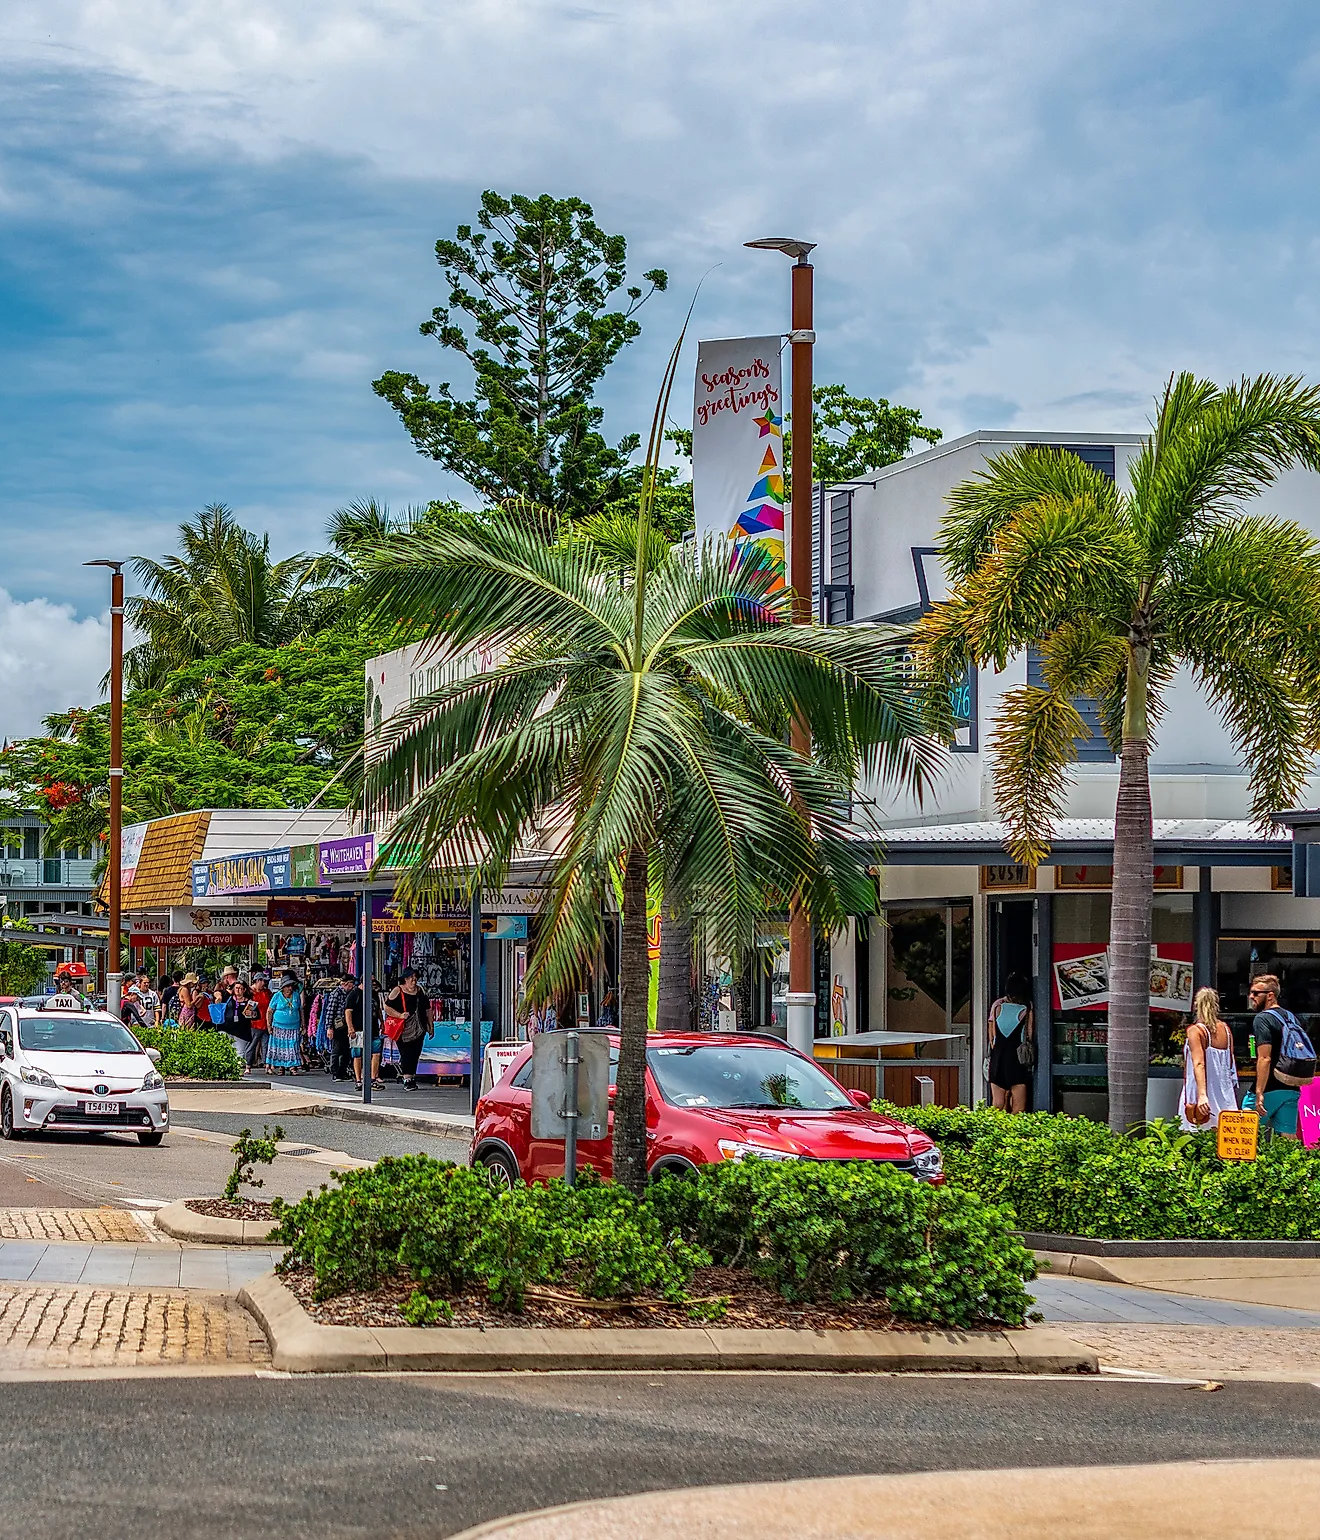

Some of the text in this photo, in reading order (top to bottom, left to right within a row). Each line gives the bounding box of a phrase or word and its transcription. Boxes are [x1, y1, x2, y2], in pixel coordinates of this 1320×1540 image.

[701, 358, 770, 393] season's
[697, 382, 779, 426] greetings
[330, 846, 364, 863] WHITEHAVEN
[481, 893, 522, 905] ROMA
[133, 920, 166, 931] WHERE
[212, 917, 257, 927] TRADING
[152, 934, 233, 946] Whitsunday Travel
[54, 999, 73, 1008] TAXI
[1222, 1115, 1257, 1125] PEDESTRIANS
[1222, 1126, 1255, 1135] ONLY CROSS
[1223, 1137, 1253, 1146] WHEN ROAD
[1234, 1148, 1250, 1156] CLEAR
